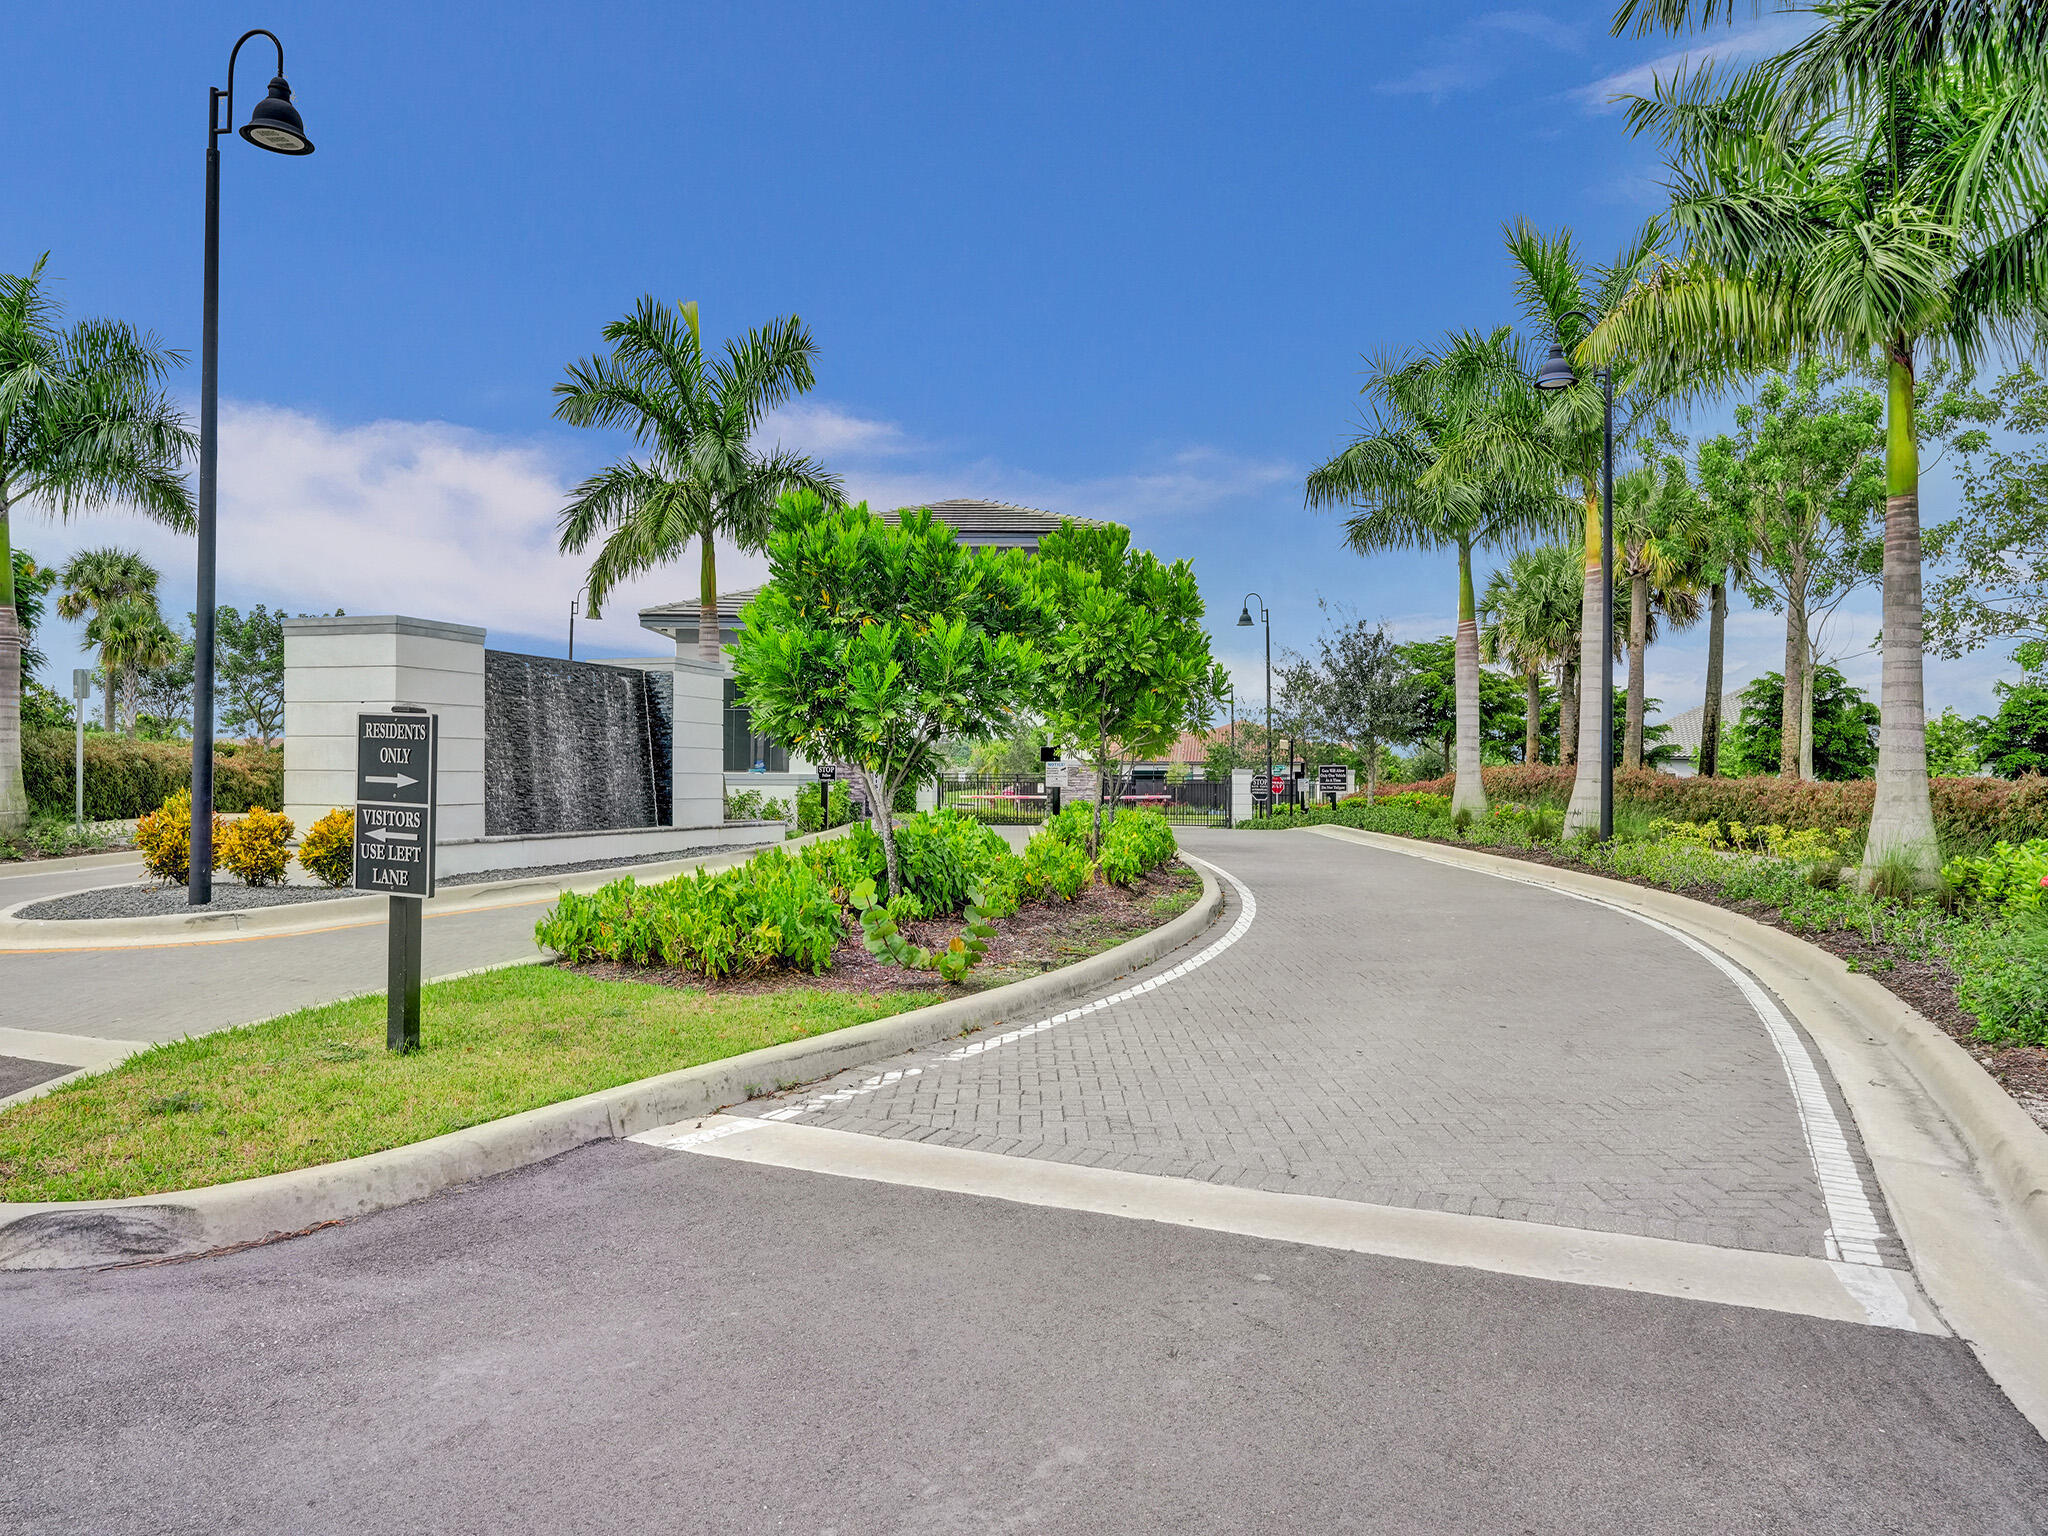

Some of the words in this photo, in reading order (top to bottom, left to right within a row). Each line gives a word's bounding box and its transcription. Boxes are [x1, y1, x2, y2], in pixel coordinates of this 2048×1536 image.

[365, 722, 426, 740] RESIDENTS
[380, 747, 411, 764] ONLY
[362, 809, 421, 828] VISITORS
[360, 843, 386, 860] USE
[387, 845, 422, 863] LEFT
[372, 868, 409, 886] LANE
